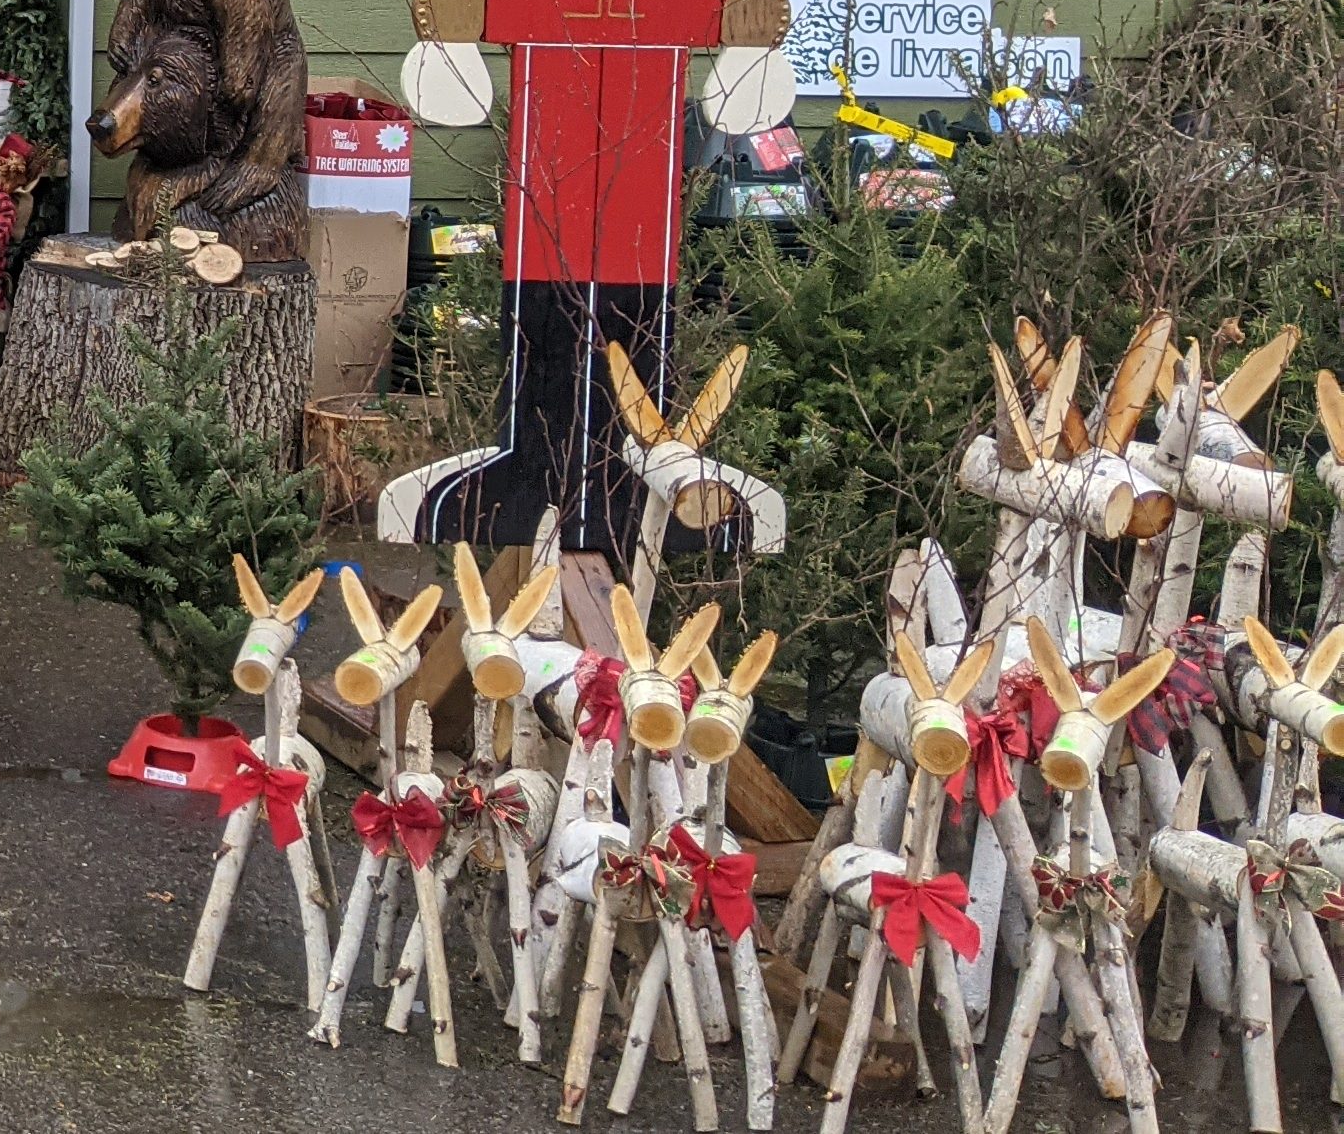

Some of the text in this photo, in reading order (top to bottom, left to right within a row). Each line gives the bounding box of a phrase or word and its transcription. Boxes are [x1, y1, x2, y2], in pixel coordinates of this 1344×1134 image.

[891, 38, 1072, 79] livrason
[315, 156, 410, 173] TREE WATERING SYSTEM
